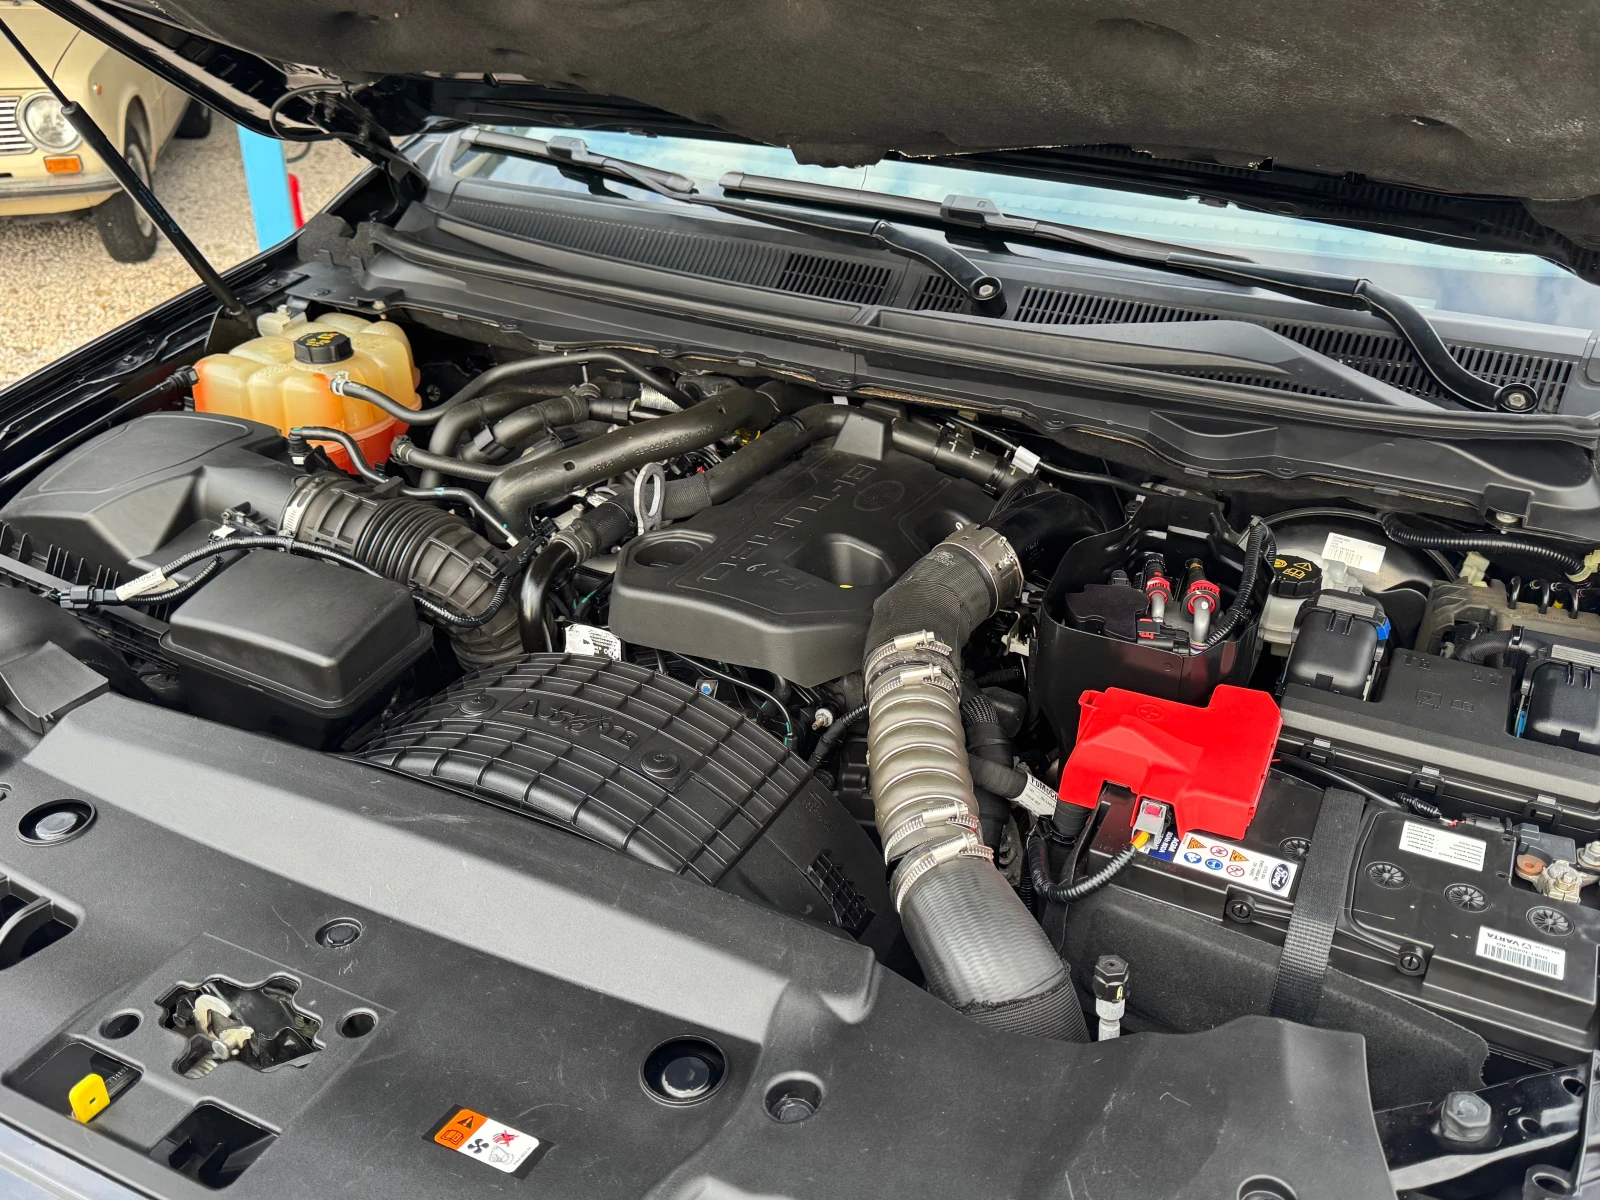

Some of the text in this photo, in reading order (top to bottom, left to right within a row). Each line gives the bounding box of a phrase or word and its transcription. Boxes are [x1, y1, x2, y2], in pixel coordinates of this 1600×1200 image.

[697, 463, 877, 583] BI-TURBO
[1168, 837, 1179, 852] AGM
[1271, 866, 1288, 888] Ford
[1487, 932, 1520, 947] VARTA
